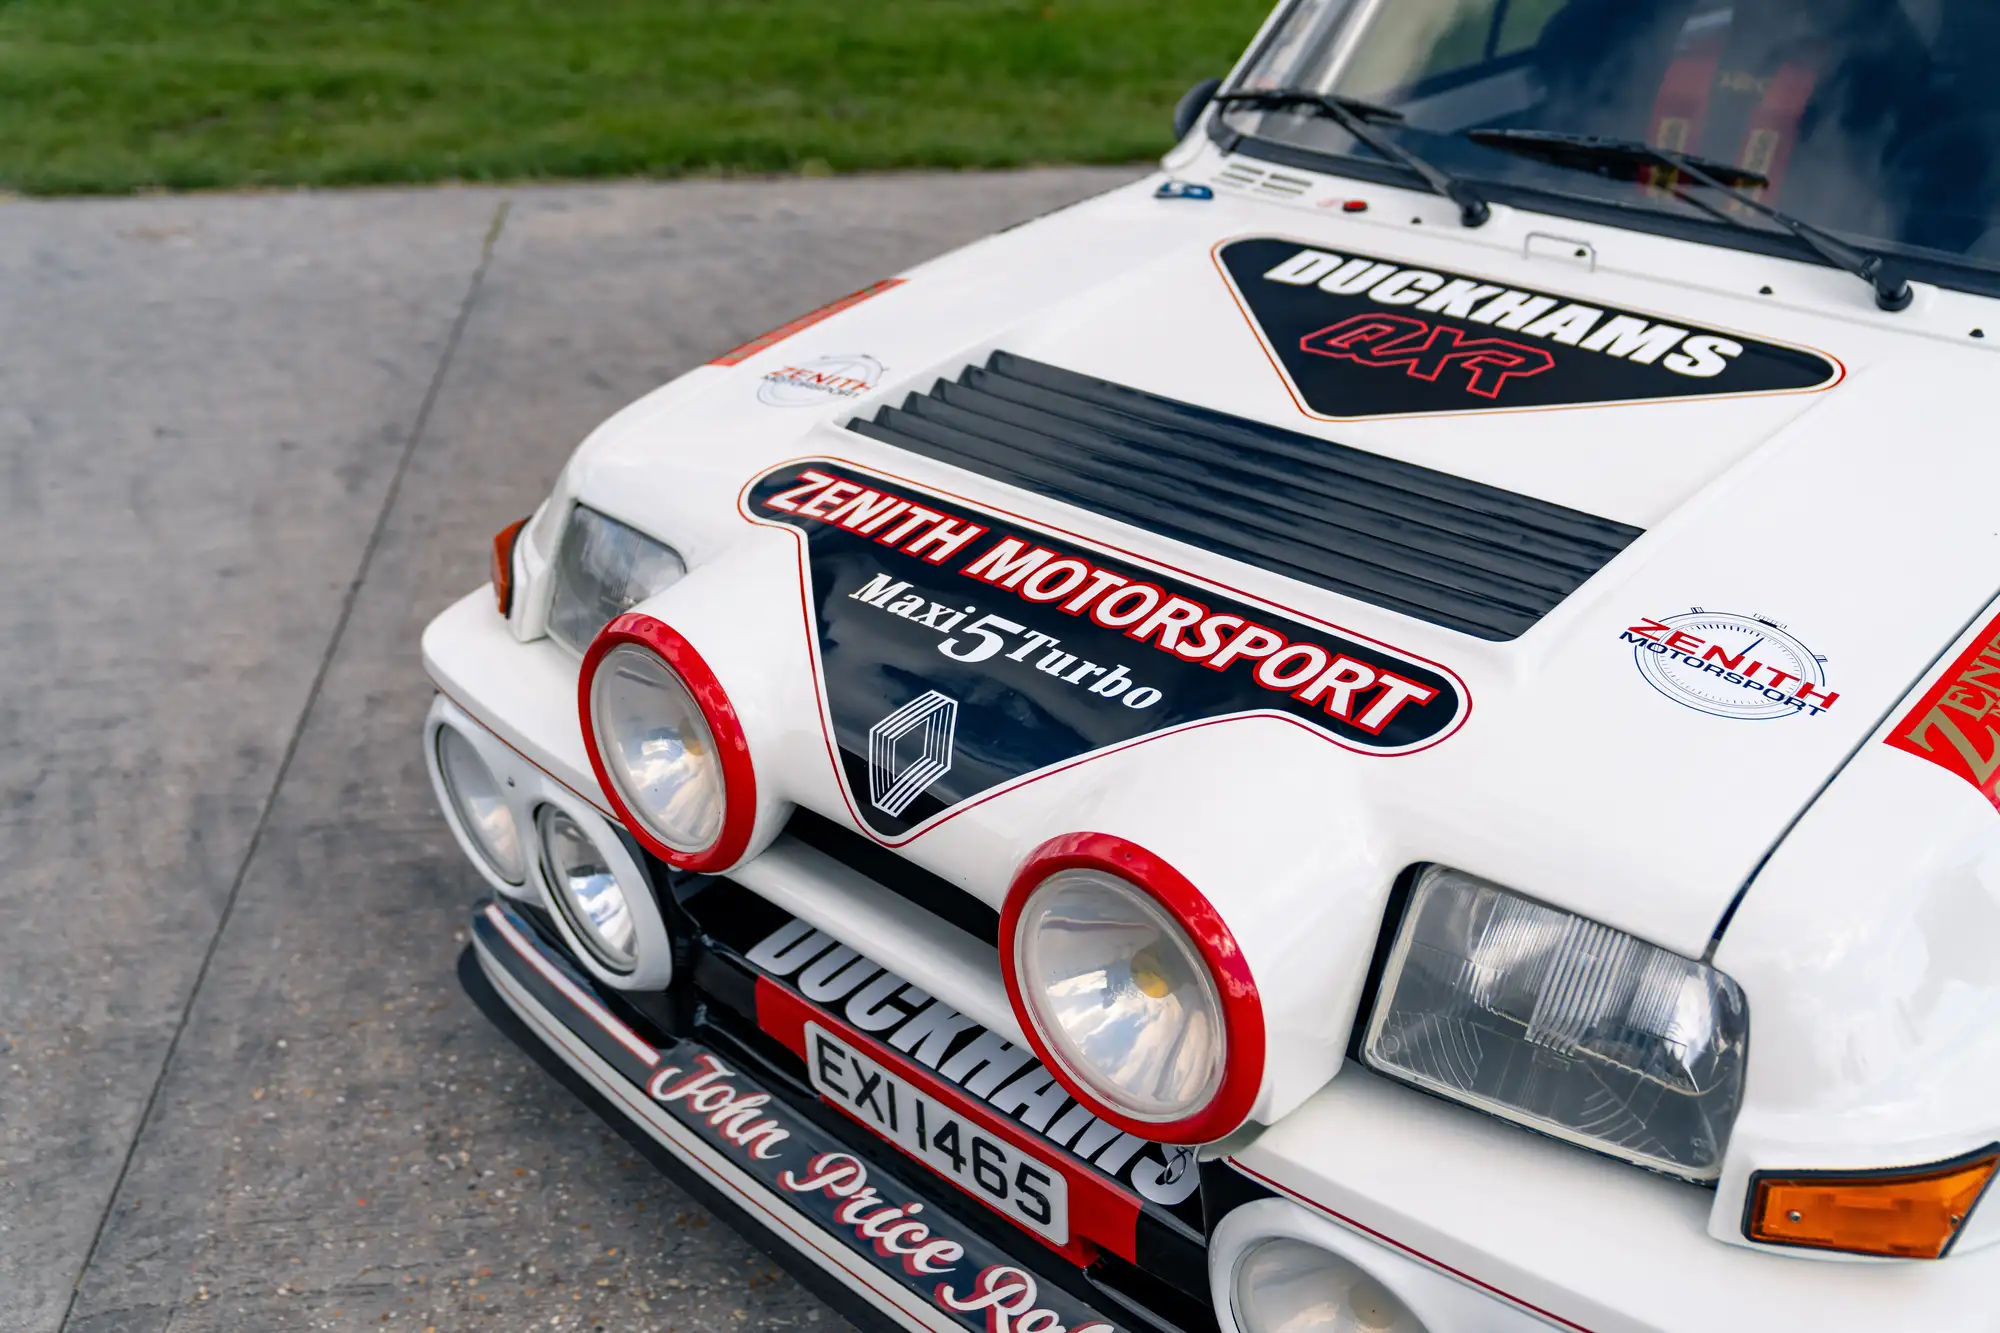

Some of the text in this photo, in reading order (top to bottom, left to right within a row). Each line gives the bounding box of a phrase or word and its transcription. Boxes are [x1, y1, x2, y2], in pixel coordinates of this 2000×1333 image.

[1262, 249, 1745, 379] DUCKHAMS
[764, 469, 1440, 736] ZENITH MOTORSPORT
[848, 572, 1163, 711] Maxi 5 Turbo
[1628, 617, 1840, 709] ZENITH
[1619, 631, 1828, 716] MOTORSPORT
[647, 1053, 1116, 1333] John Price Ra
[816, 1033, 1051, 1226] EXI 1465
